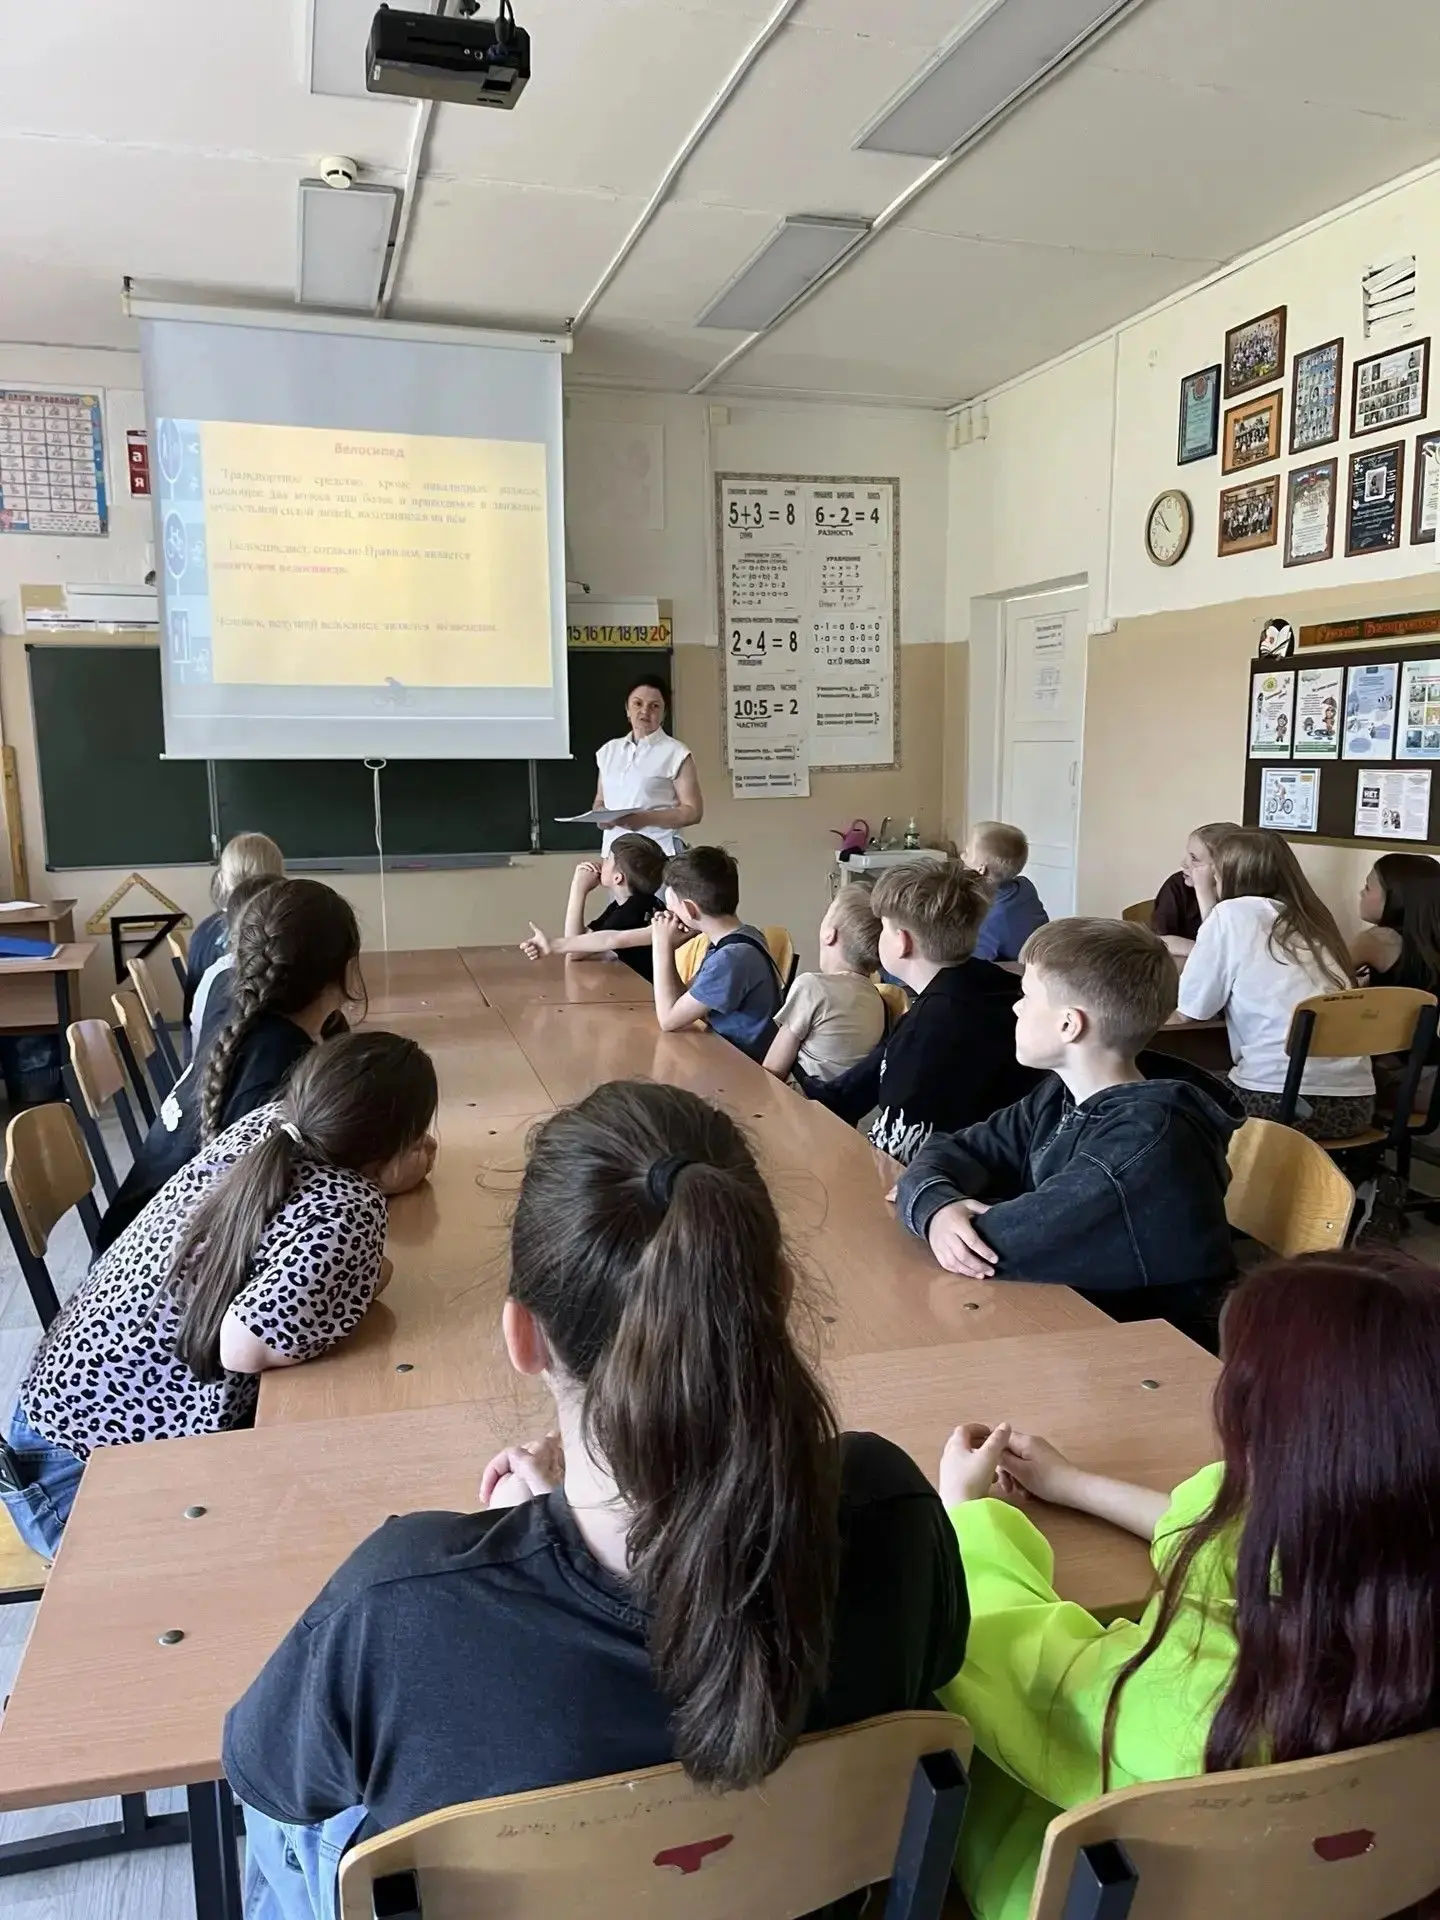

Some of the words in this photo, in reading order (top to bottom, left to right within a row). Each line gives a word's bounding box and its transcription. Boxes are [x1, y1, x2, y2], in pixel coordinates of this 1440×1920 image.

[334, 443, 405, 458] Велосипед
[786, 503, 796, 526] 8
[870, 508, 880, 524] 4
[567, 626, 580, 640] 15
[584, 626, 598, 640] 16
[600, 626, 614, 641] 17
[617, 626, 632, 641] 18
[634, 626, 648, 641] 19
[650, 624, 666, 641] 20
[790, 630, 798, 652] 8
[789, 698, 799, 715] 2
